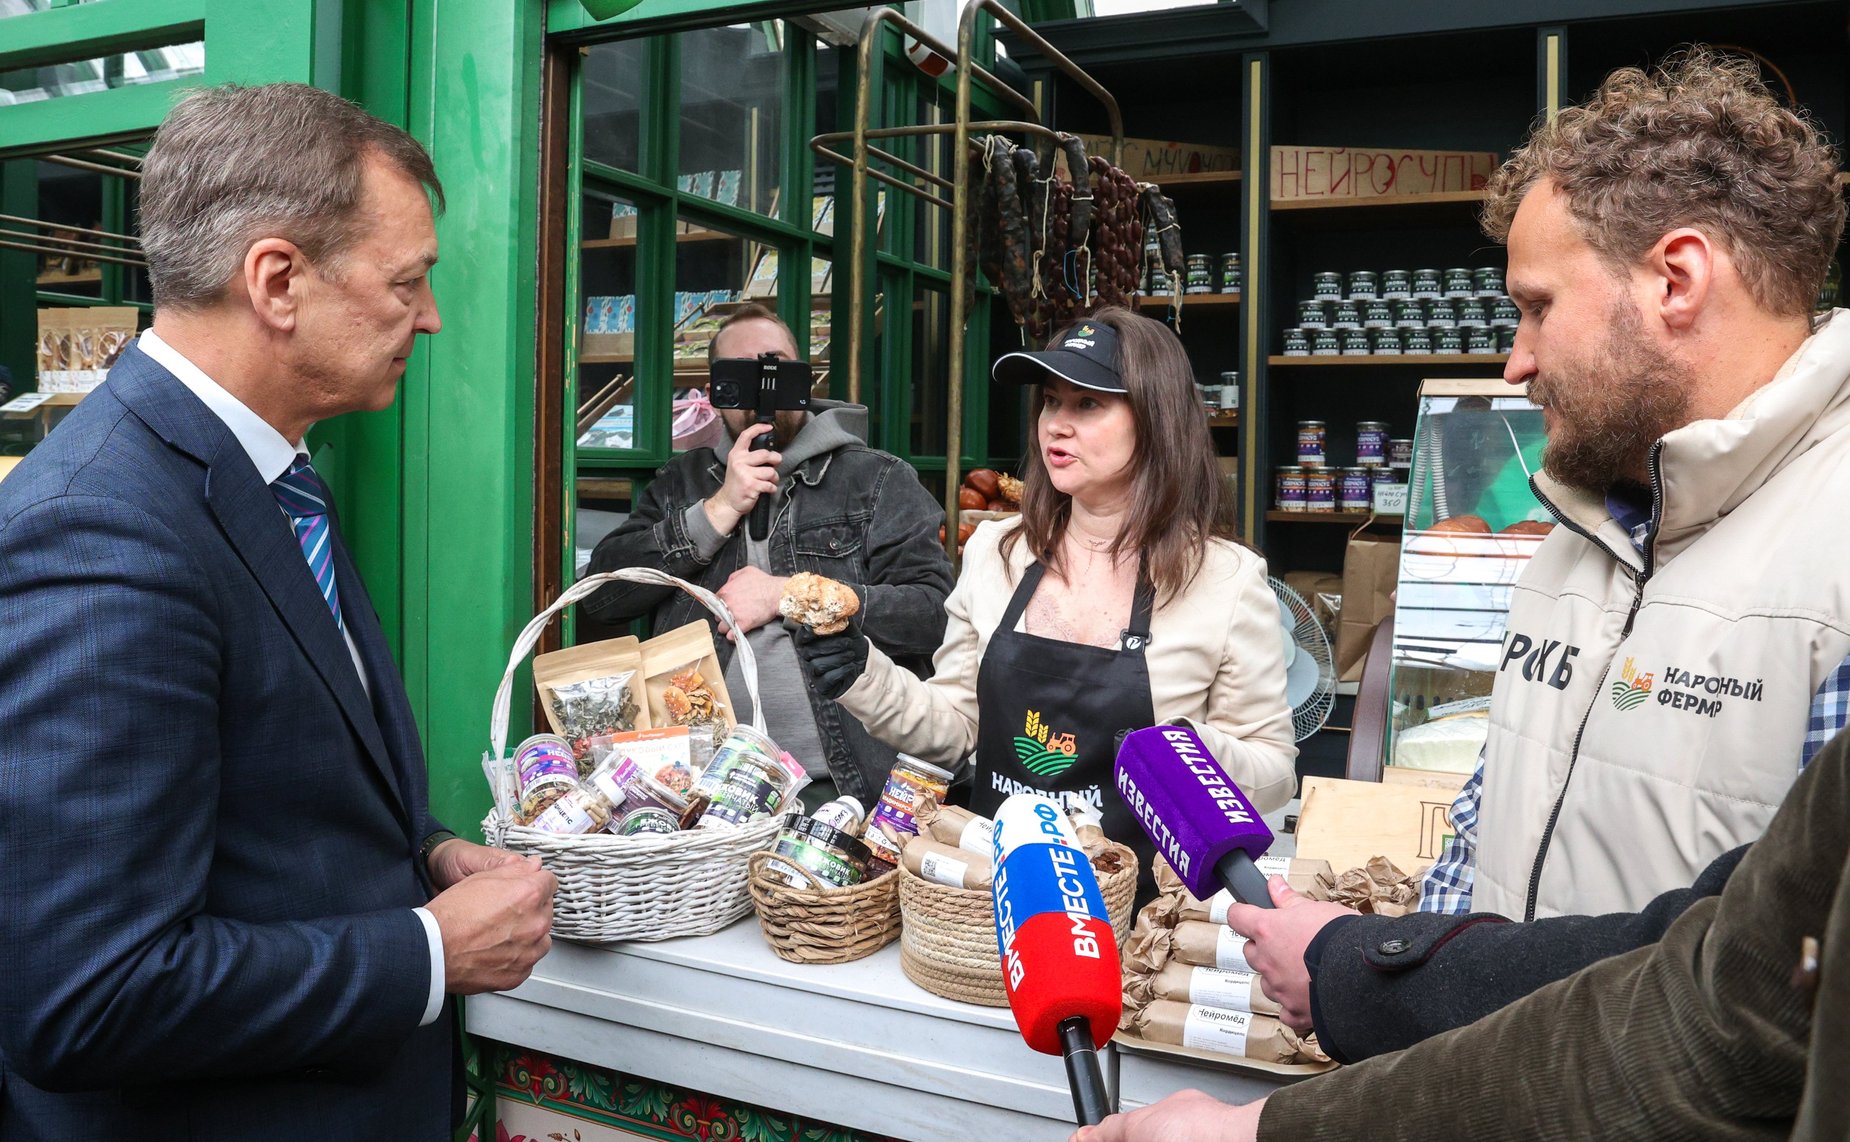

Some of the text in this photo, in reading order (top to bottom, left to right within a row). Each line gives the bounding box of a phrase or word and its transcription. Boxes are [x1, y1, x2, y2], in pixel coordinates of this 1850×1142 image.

[1117, 766, 1191, 878] ИЗВЕСТИЯ
[1162, 730, 1254, 824] ИЗВЕСТИЯ
[1199, 1008, 1245, 1025] Нейромёд
